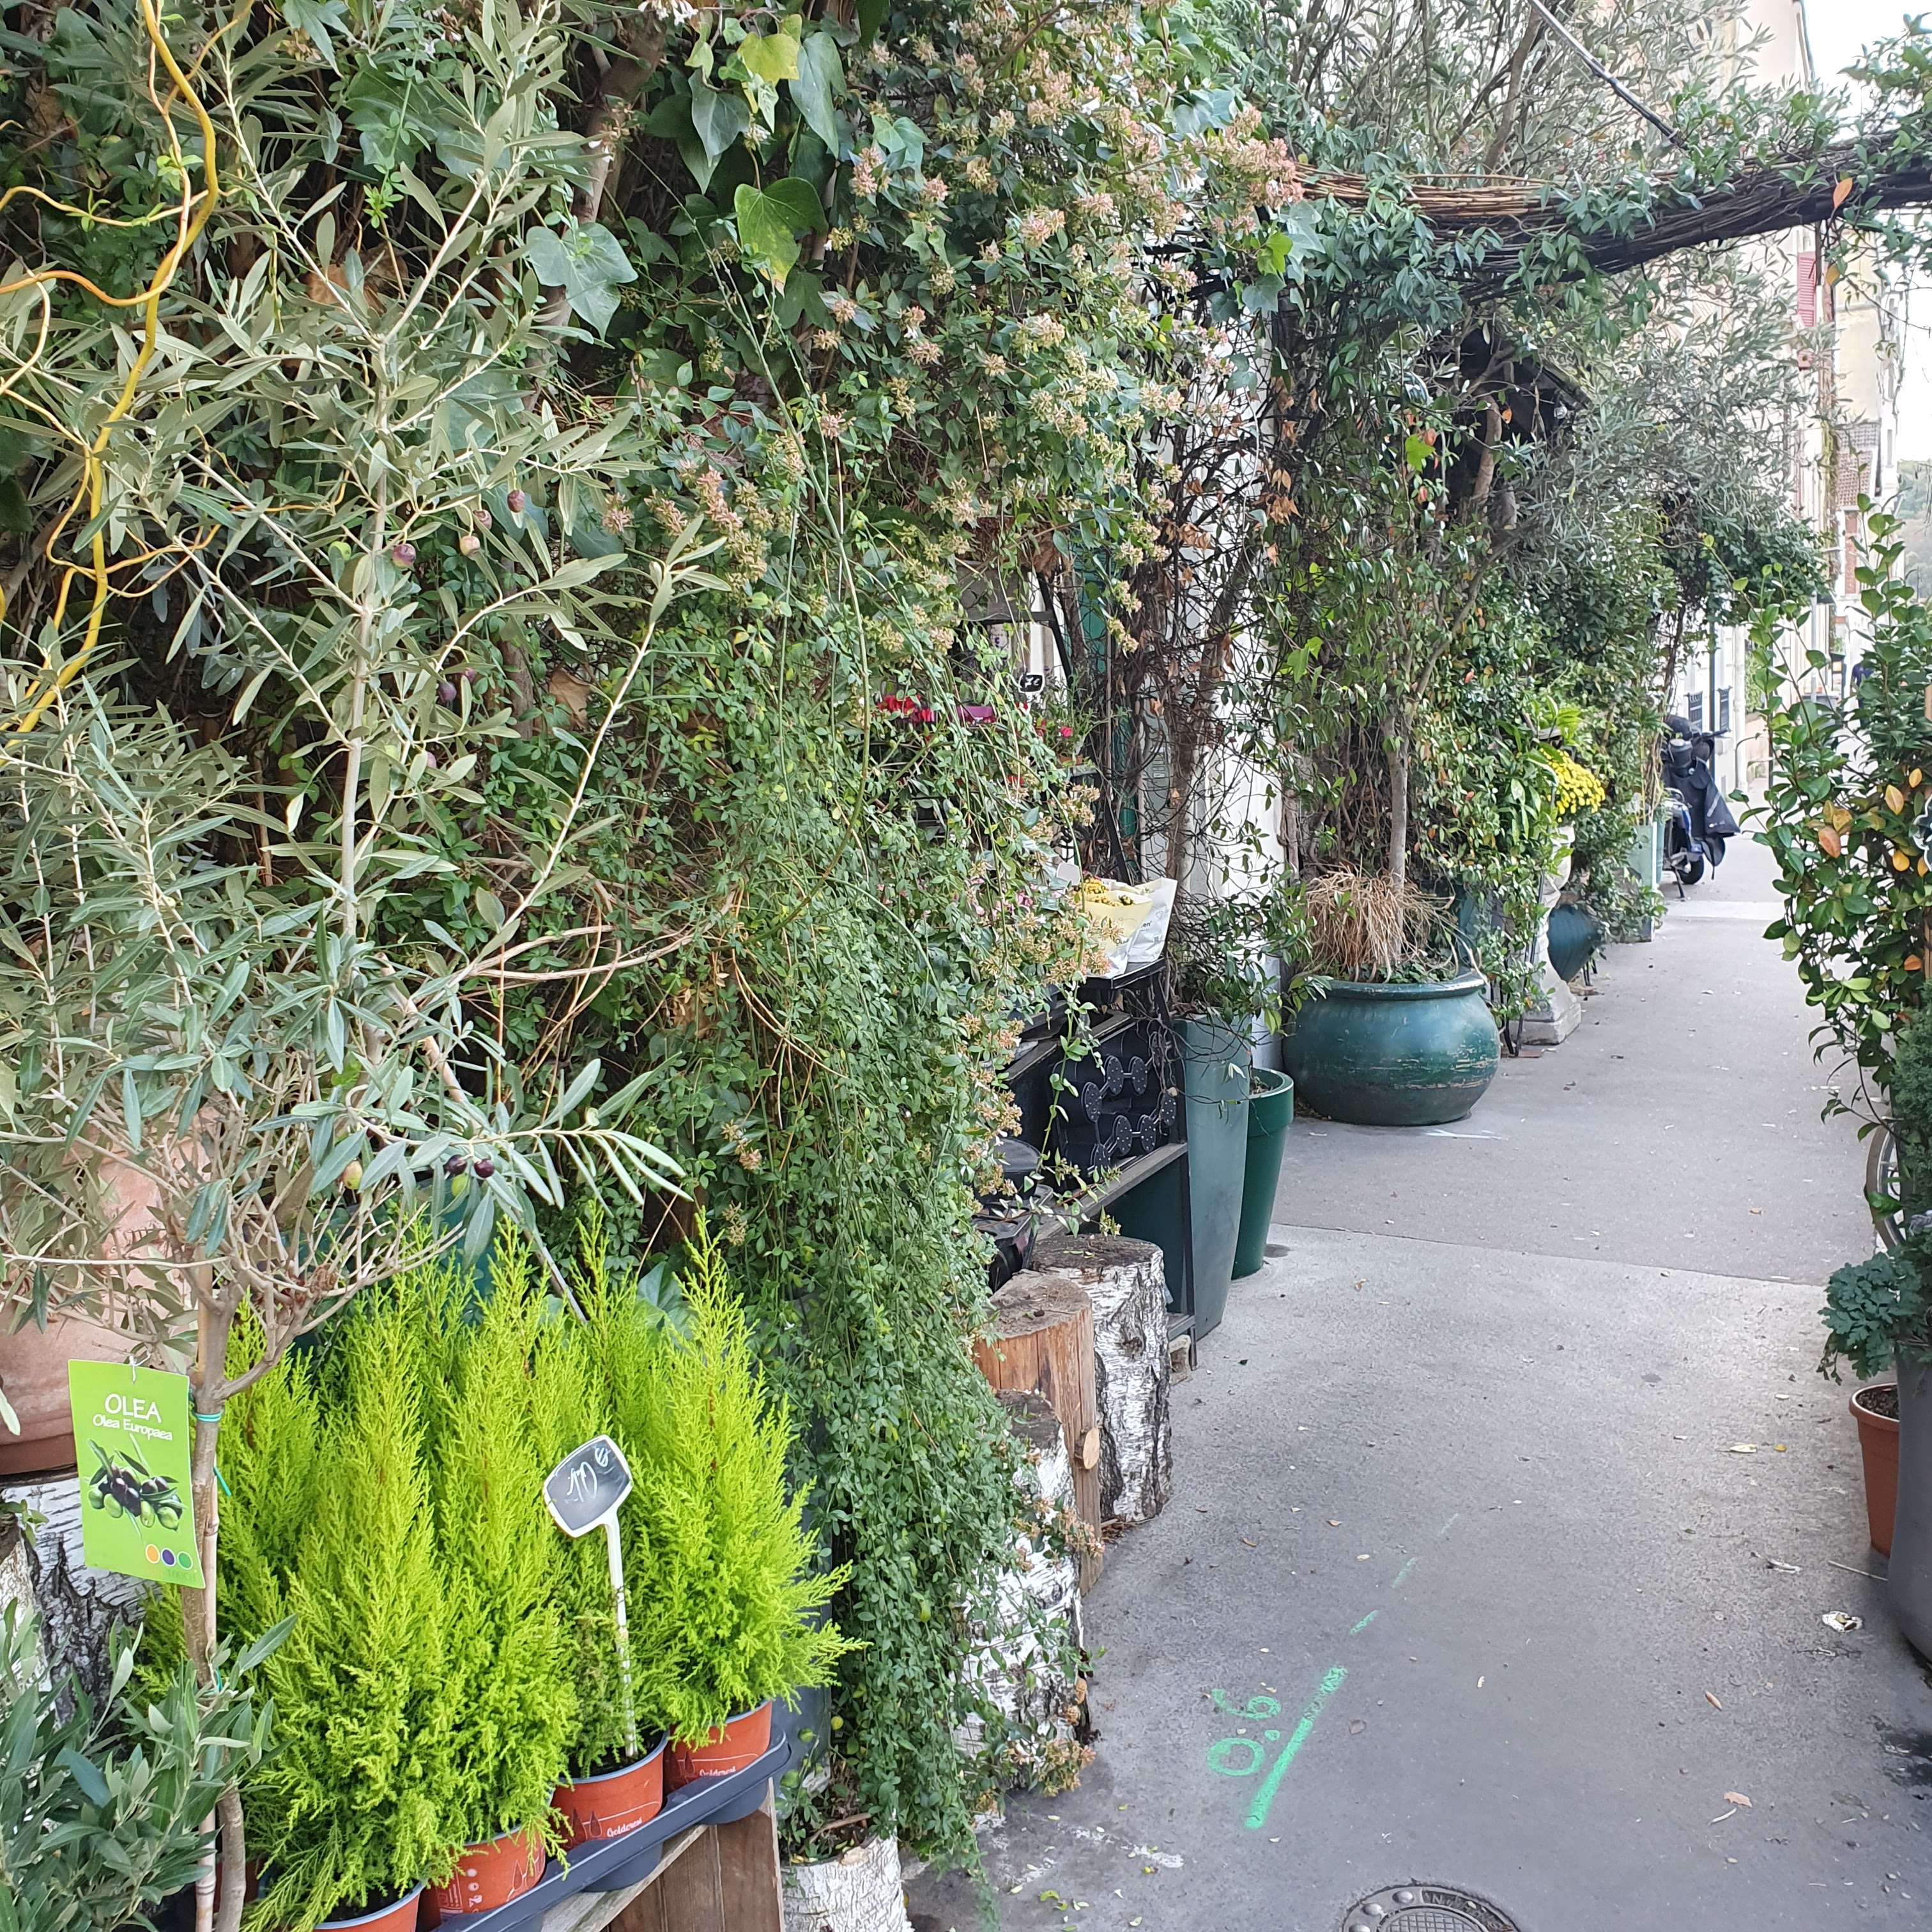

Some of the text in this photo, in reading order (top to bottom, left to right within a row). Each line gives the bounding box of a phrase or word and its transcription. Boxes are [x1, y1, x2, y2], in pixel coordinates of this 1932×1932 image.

[104, 1393, 162, 1423] OLEA
[93, 1414, 120, 1429] Olea
[123, 1418, 173, 1441] Europaea
